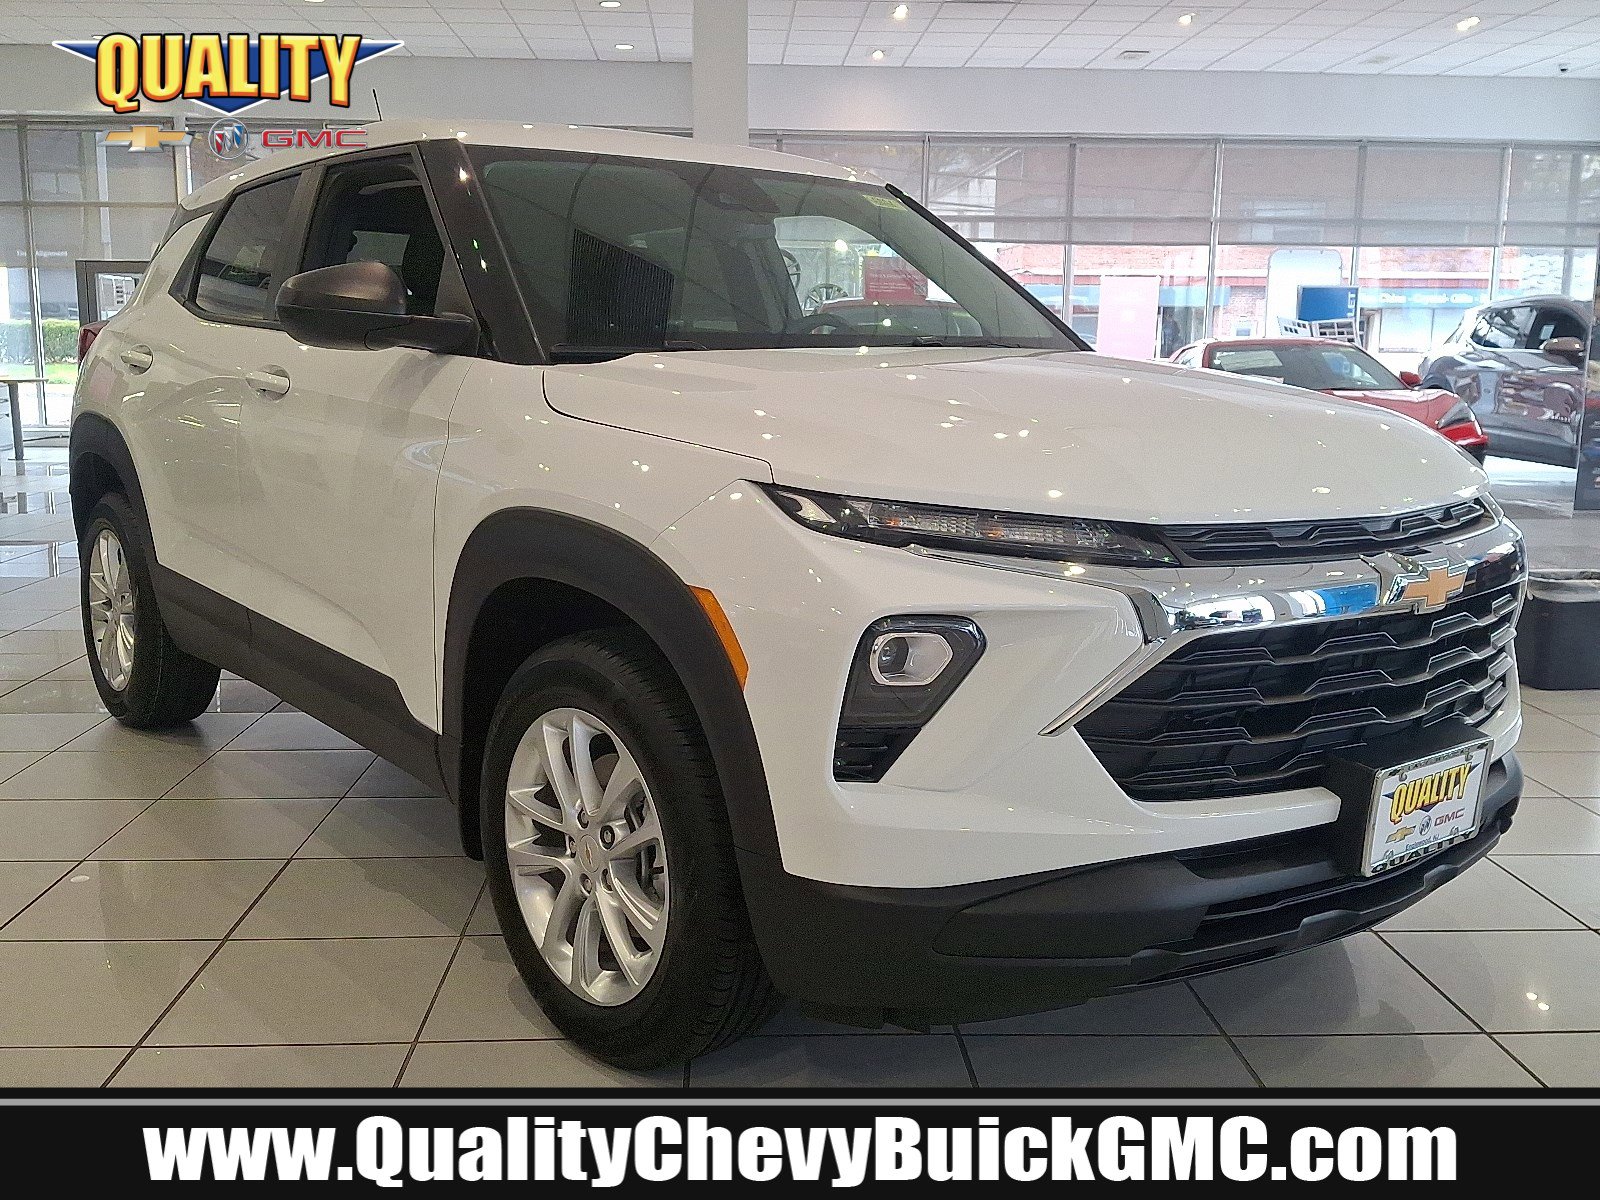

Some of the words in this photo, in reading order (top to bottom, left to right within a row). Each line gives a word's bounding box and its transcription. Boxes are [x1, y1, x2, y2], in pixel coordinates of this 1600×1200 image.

[1390, 762, 1473, 825] QUALITY
[1434, 808, 1465, 827] GMC
[1371, 831, 1470, 874] QUALITY
